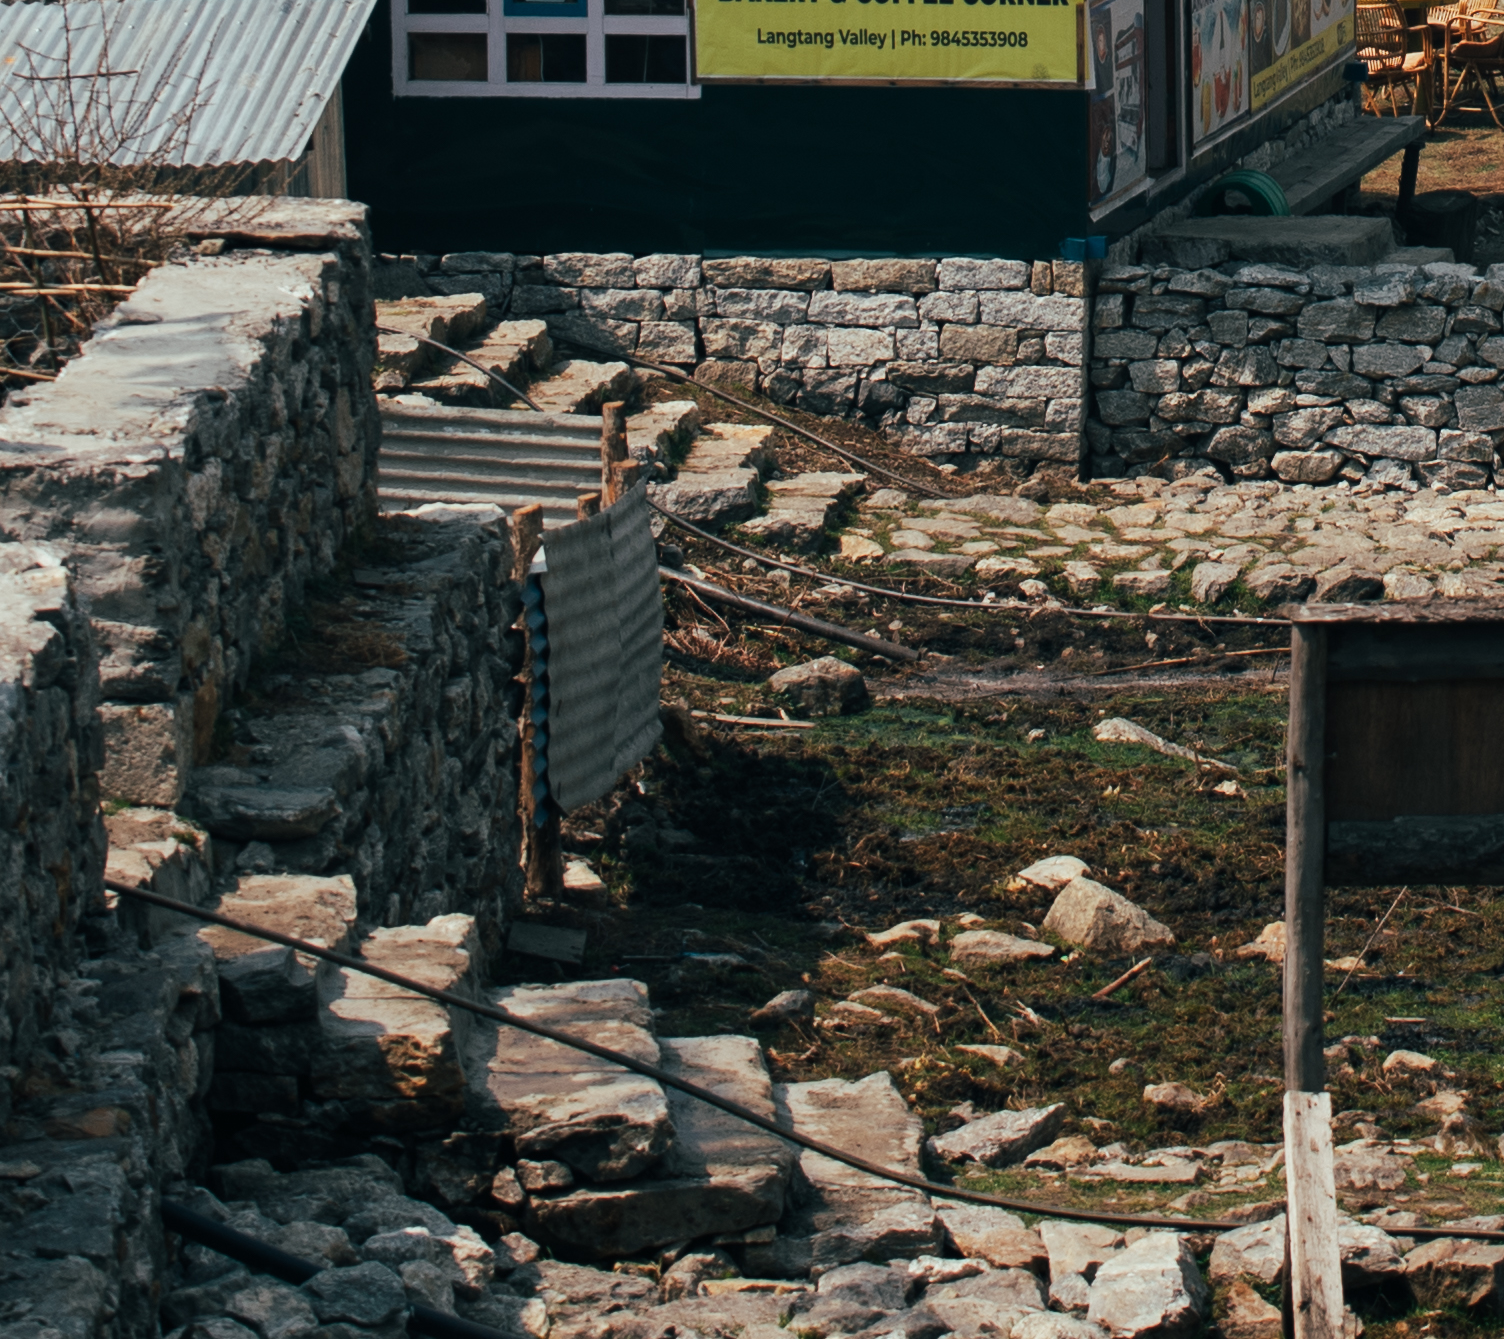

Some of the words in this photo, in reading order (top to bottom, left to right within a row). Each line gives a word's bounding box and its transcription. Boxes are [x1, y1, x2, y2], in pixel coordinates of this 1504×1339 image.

[757, 29, 834, 48] Langtang
[839, 29, 887, 49] Valley
[901, 30, 927, 46] Ph:
[930, 31, 1028, 48] 9845353908
